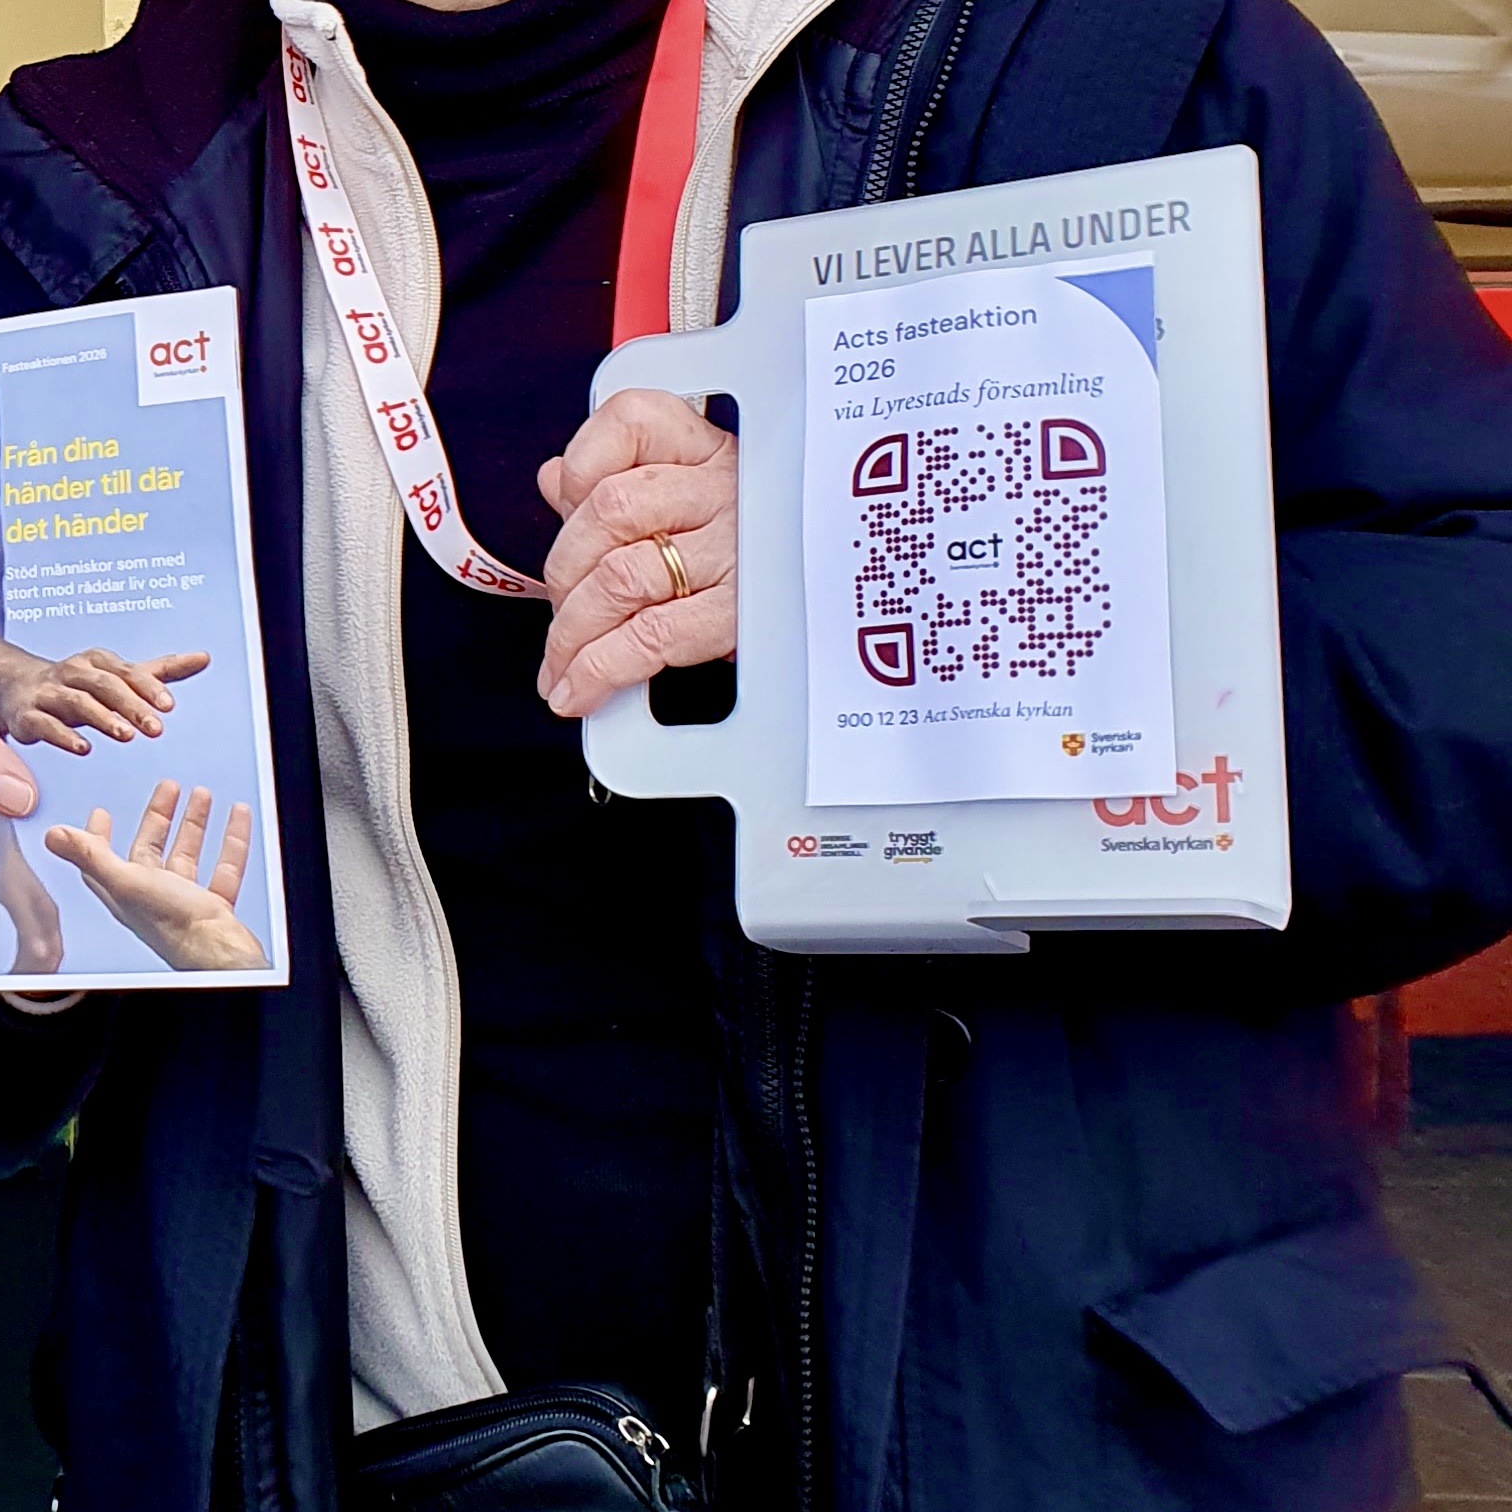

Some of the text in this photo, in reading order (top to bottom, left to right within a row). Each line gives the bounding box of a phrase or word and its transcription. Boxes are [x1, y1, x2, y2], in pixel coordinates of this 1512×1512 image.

[285, 45, 308, 104] act
[297, 134, 328, 190] act
[318, 222, 356, 277] act
[813, 200, 1192, 285] VI LEVER ALLA UNDER
[346, 308, 390, 364] act
[833, 306, 1037, 351] Acts fasteaktion
[149, 330, 211, 367] act
[833, 358, 896, 385] 2026
[833, 372, 1105, 421] via Lyrestads församling
[376, 400, 419, 452] act
[3, 436, 120, 469] Från dina
[4, 466, 185, 506] händer till där
[408, 479, 443, 531] act
[5, 507, 149, 544] det händer
[947, 532, 1003, 561] act
[5, 551, 186, 581] Stöd människor som med
[456, 557, 526, 593] act
[5, 585, 39, 602] stort
[41, 581, 75, 598] mod
[129, 576, 146, 591] liv
[148, 573, 177, 589] och
[180, 573, 206, 591] ger
[5, 606, 43, 623] hopp
[45, 602, 76, 618] mitt
[78, 601, 84, 614] i
[837, 699, 1073, 728] 900 12 23 Act Svenska kyrkan
[1091, 730, 1142, 743] Svenska
[1091, 742, 1134, 756] kyrkan
[883, 844, 943, 860] givande
[888, 830, 936, 847] tryggt
[1101, 835, 1214, 855] Svenska kyrkan
